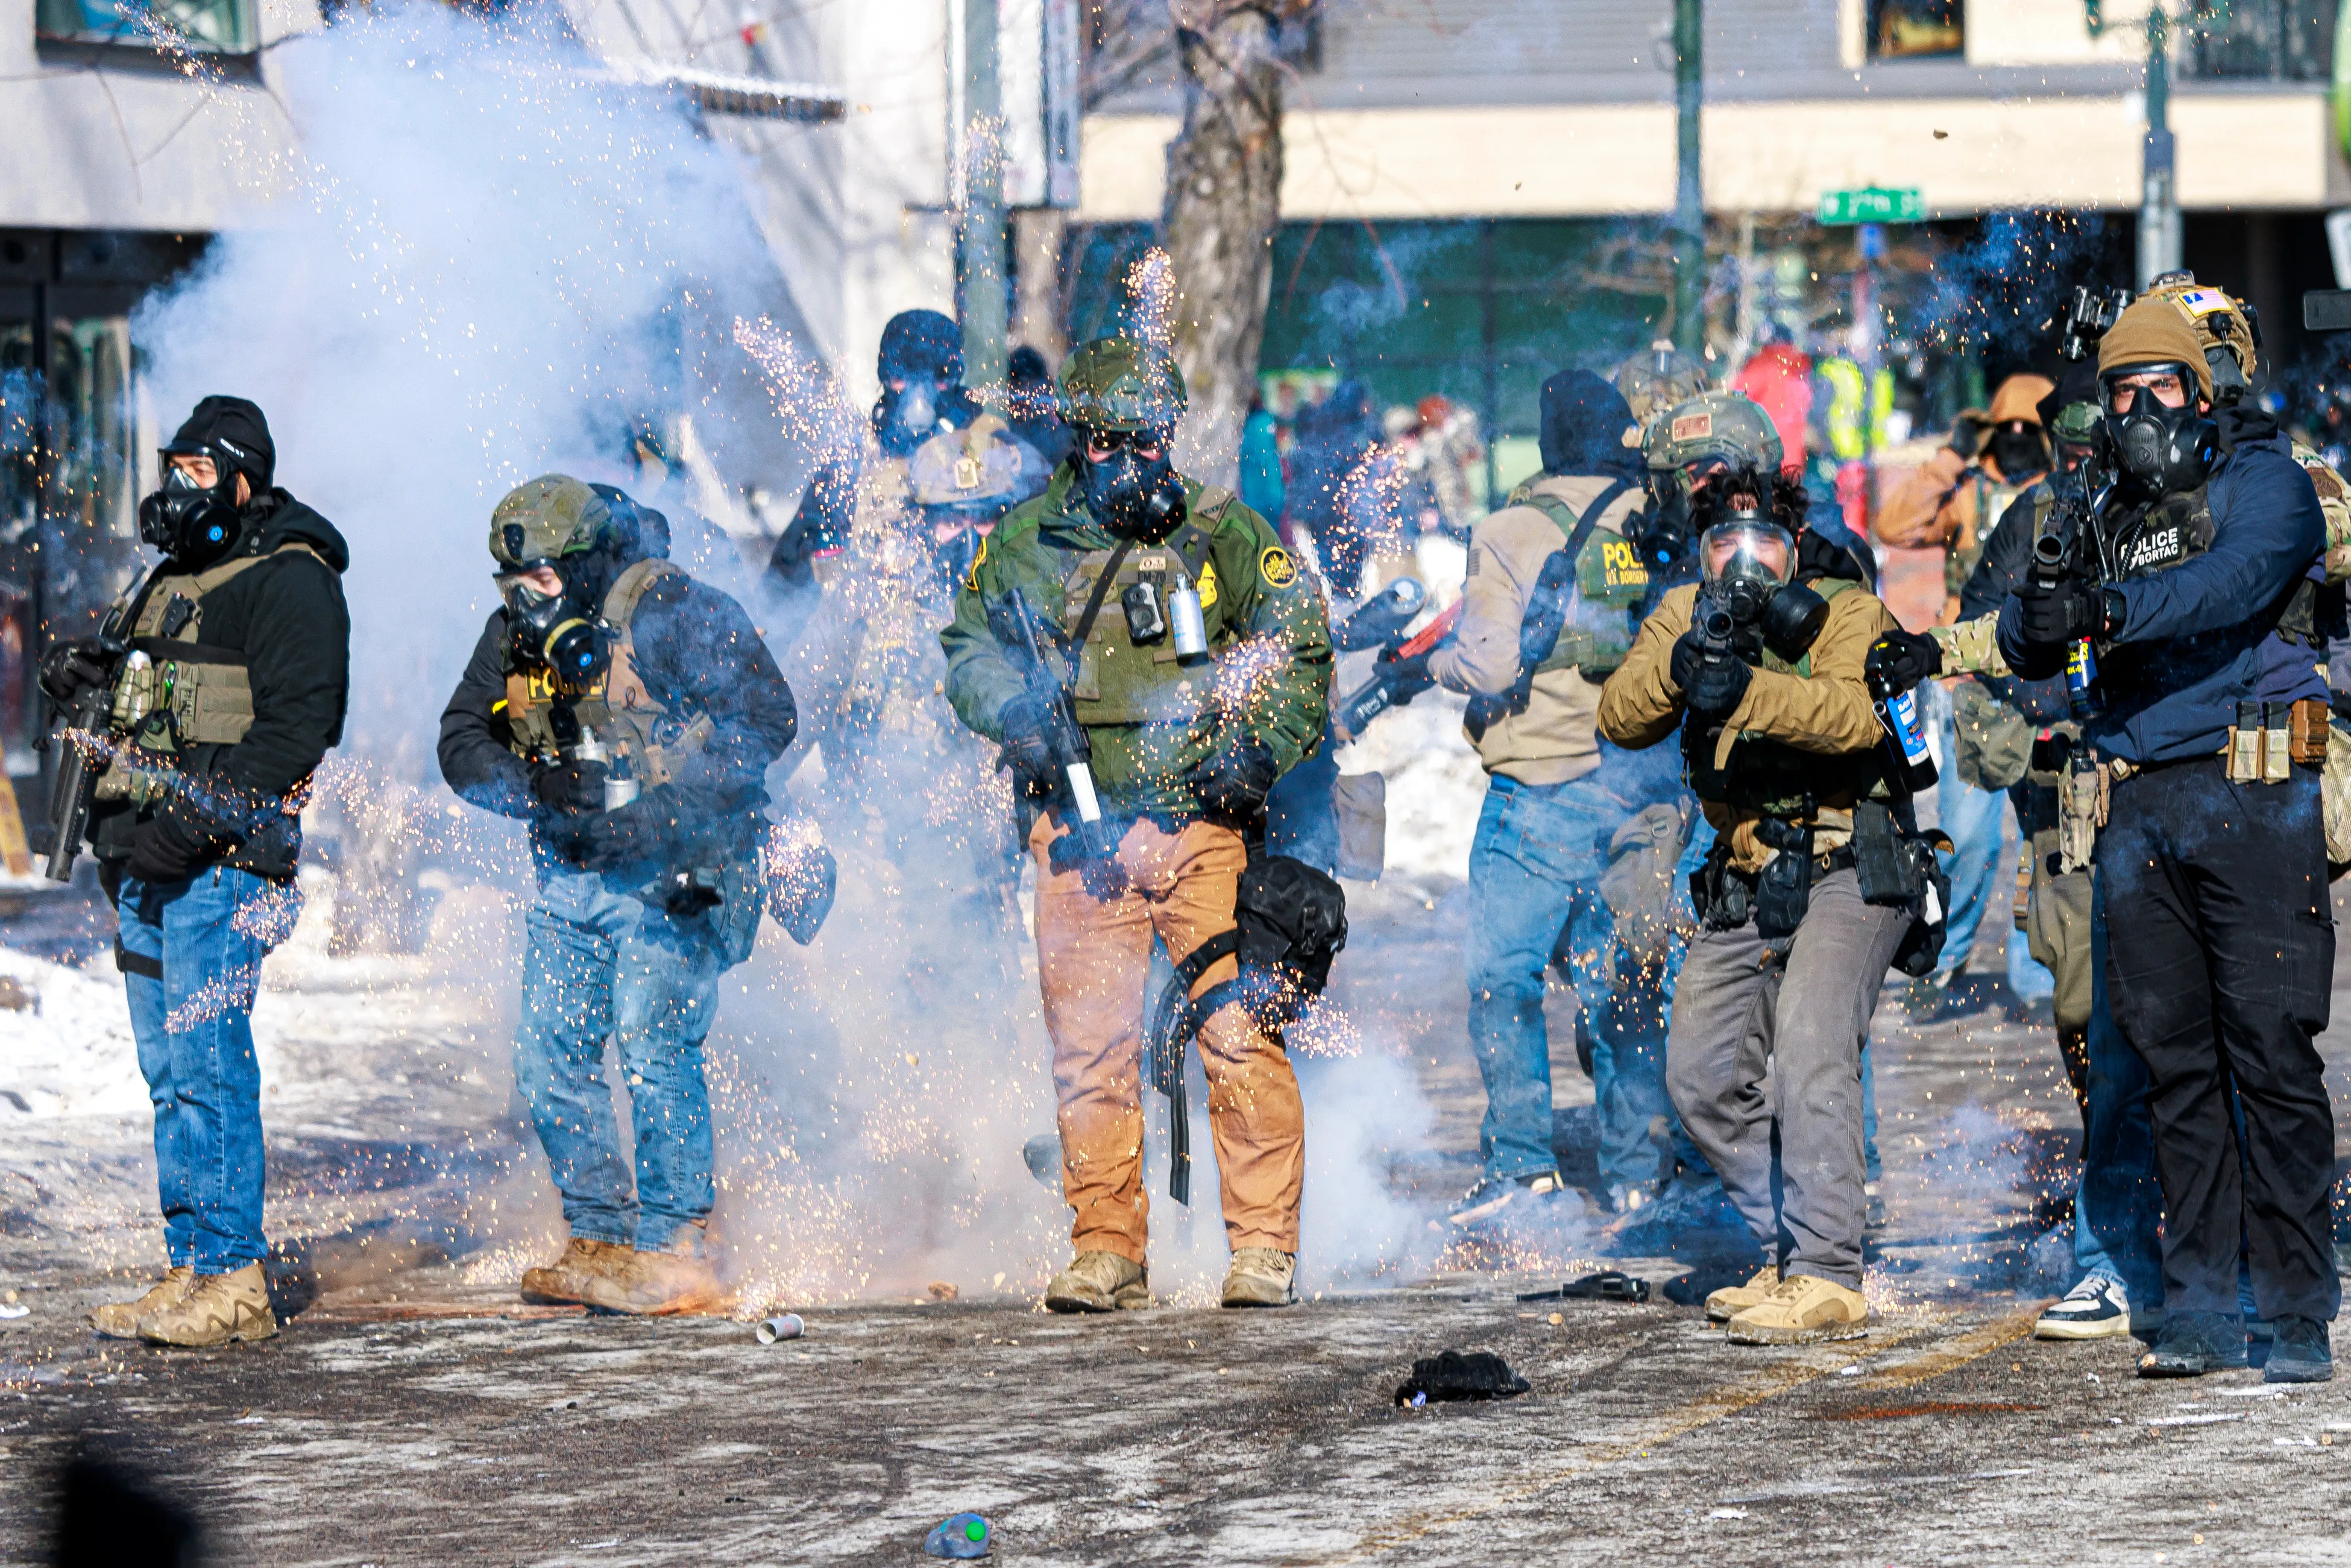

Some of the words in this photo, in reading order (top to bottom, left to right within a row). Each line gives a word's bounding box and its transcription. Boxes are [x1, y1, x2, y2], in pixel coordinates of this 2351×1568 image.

[1603, 542, 1644, 570] POL
[2138, 543, 2178, 566] BORTAC
[1619, 570, 1644, 585] BORDER
